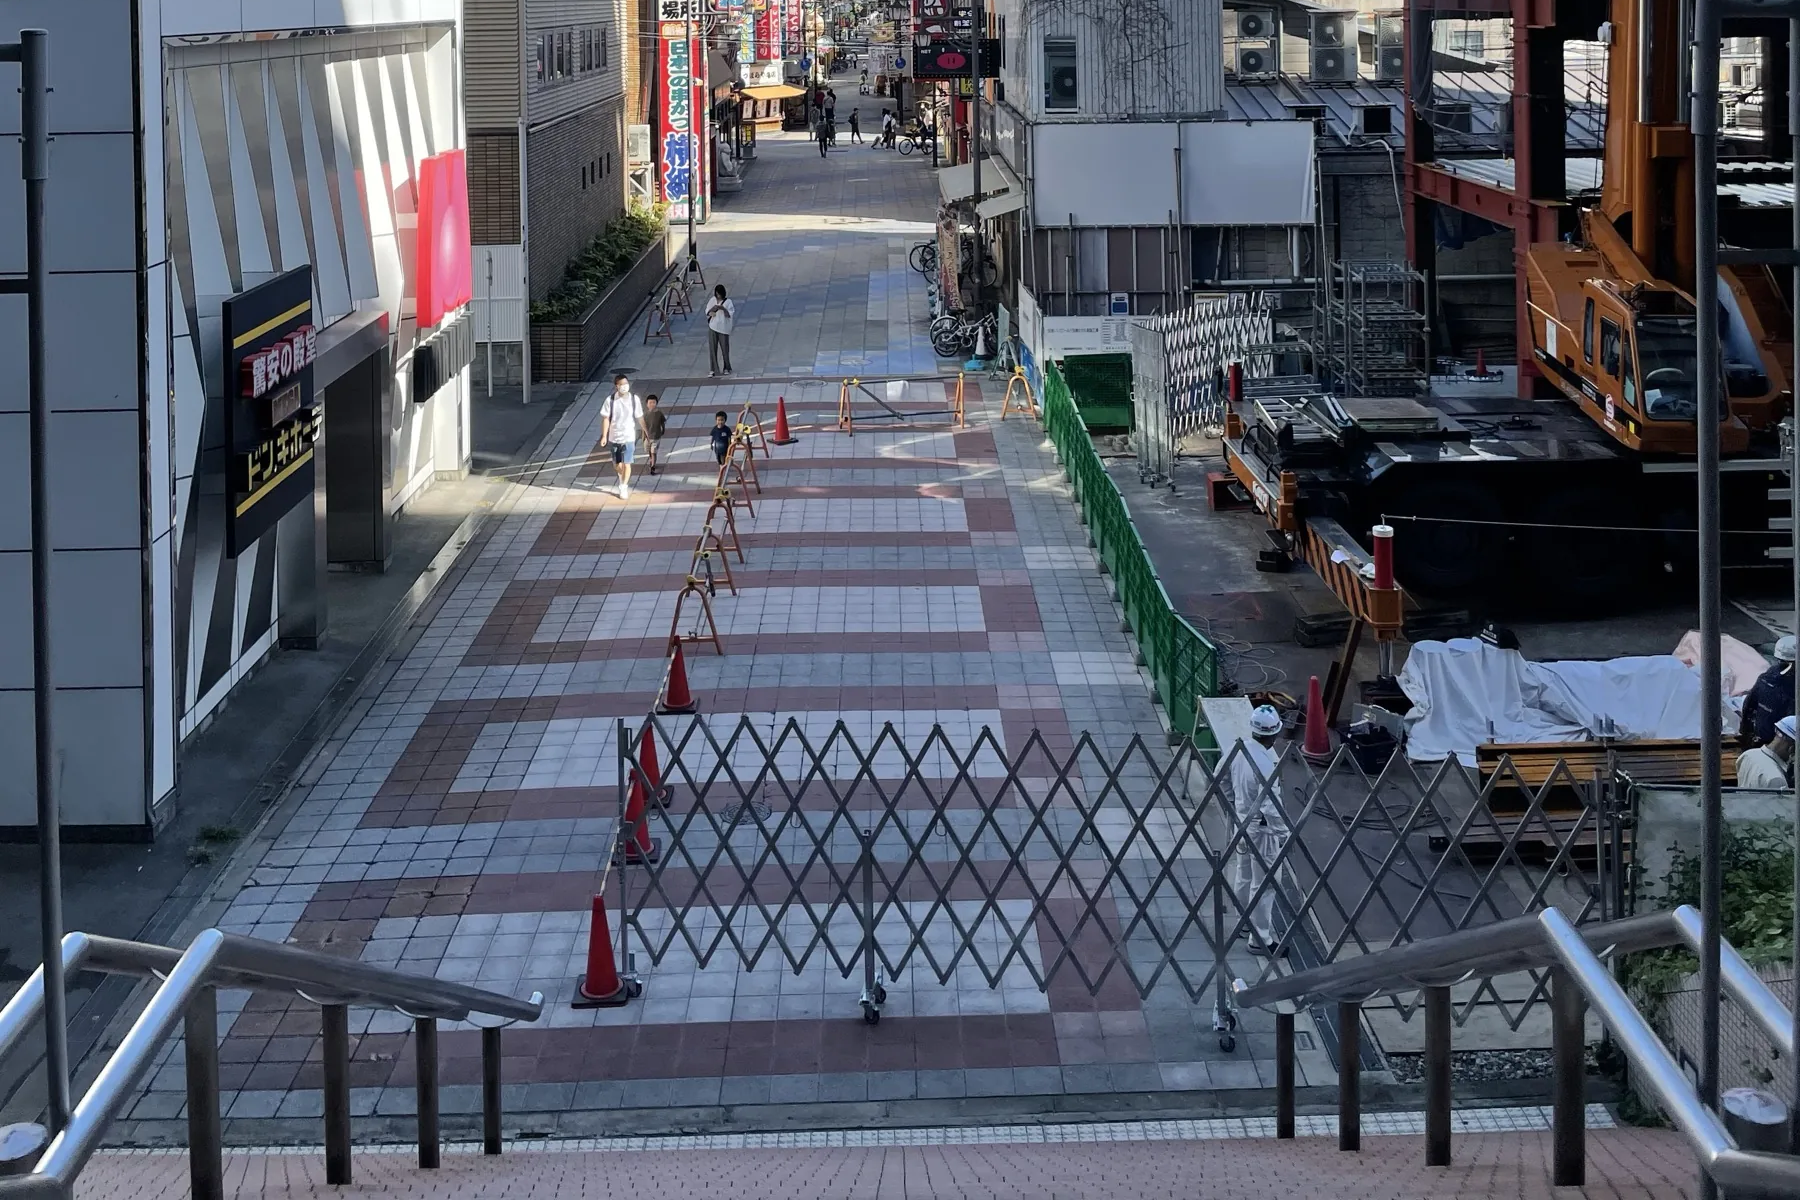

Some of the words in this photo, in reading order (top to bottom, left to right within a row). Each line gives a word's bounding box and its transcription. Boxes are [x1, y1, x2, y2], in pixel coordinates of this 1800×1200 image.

[252, 327, 318, 399] 驚安の殿堂
